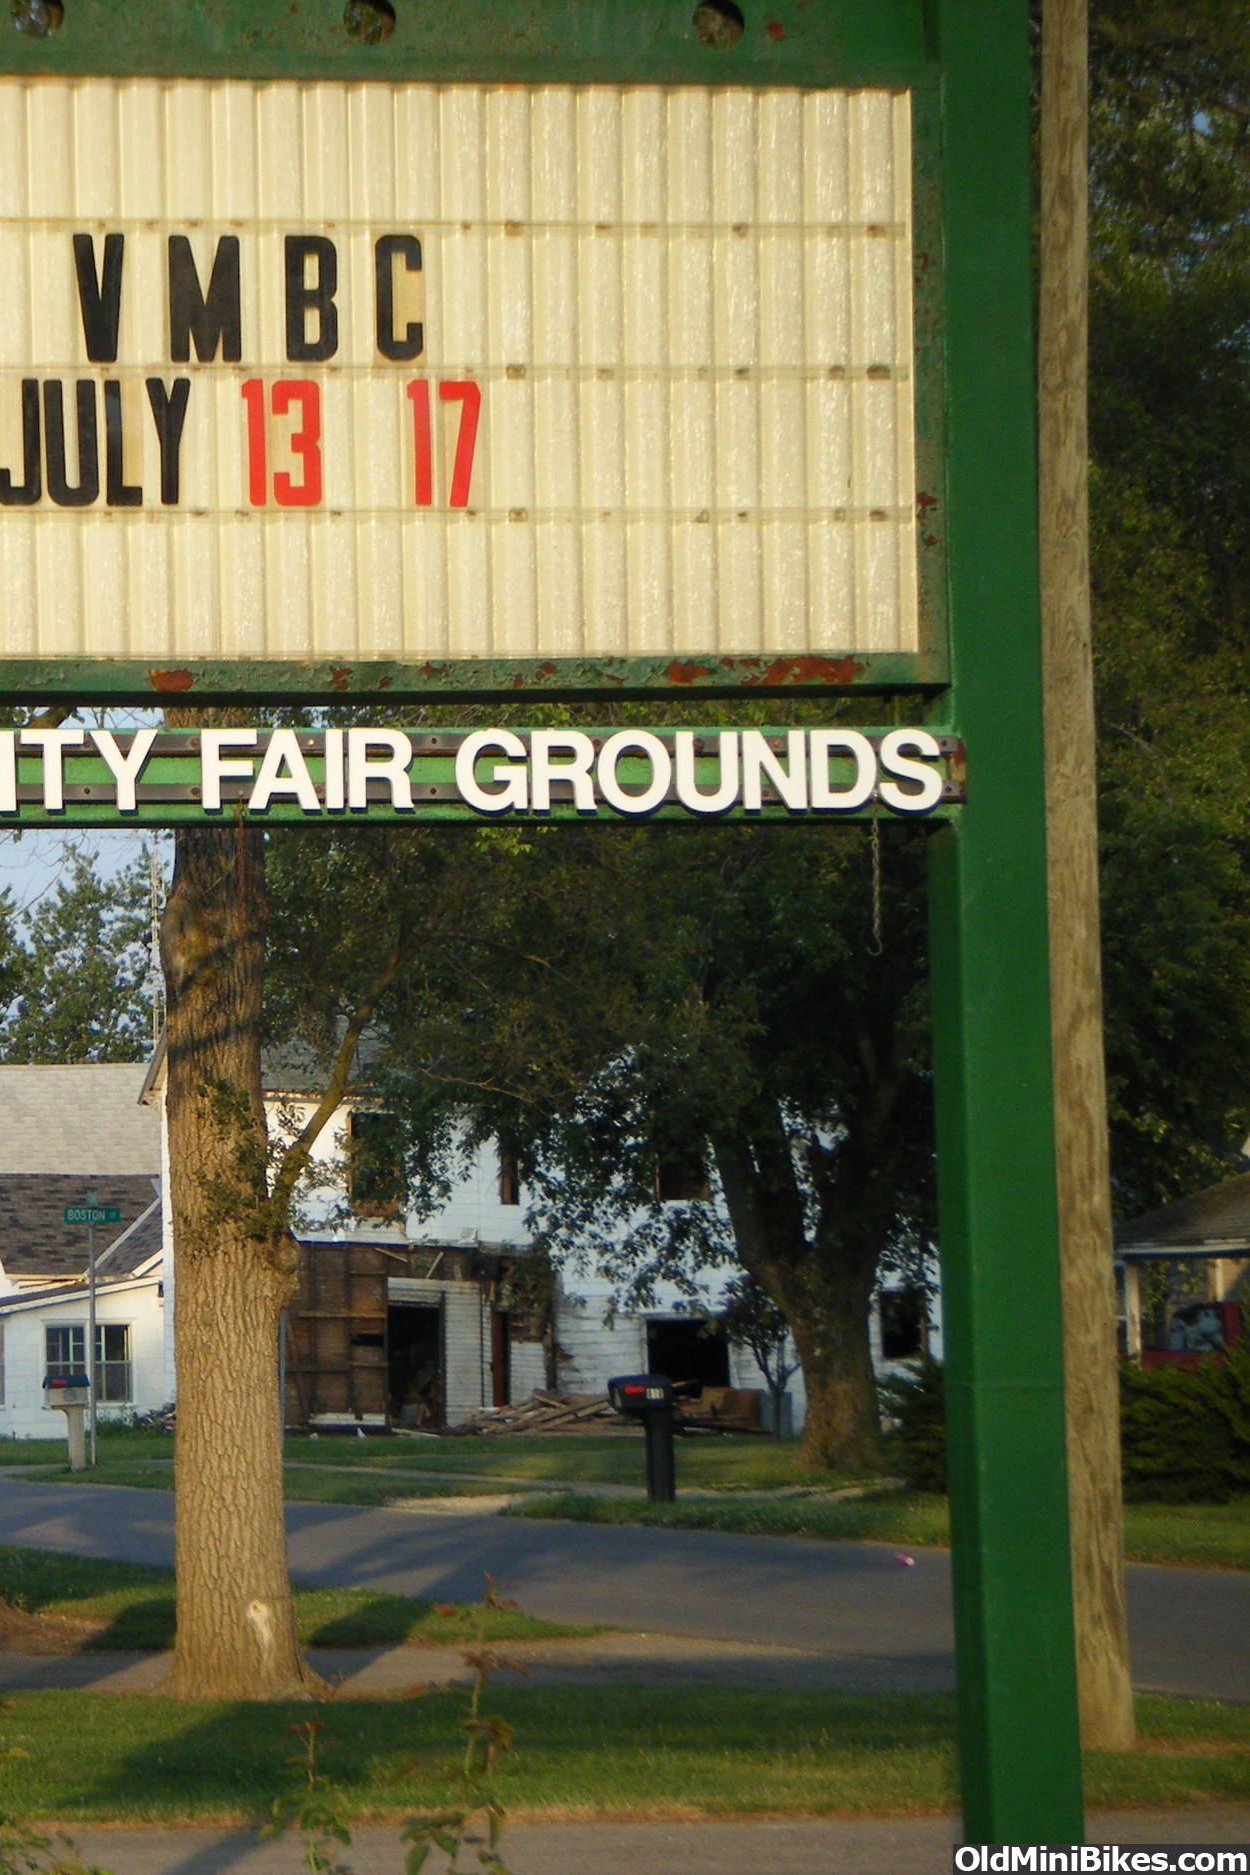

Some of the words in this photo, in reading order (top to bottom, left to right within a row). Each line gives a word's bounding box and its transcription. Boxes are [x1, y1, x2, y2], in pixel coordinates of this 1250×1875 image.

[241, 378, 323, 507] 13
[406, 379, 482, 508] 17
[200, 729, 414, 811] FAIR
[454, 728, 942, 813] GROUNDS
[67, 1209, 106, 1221] BOSTON
